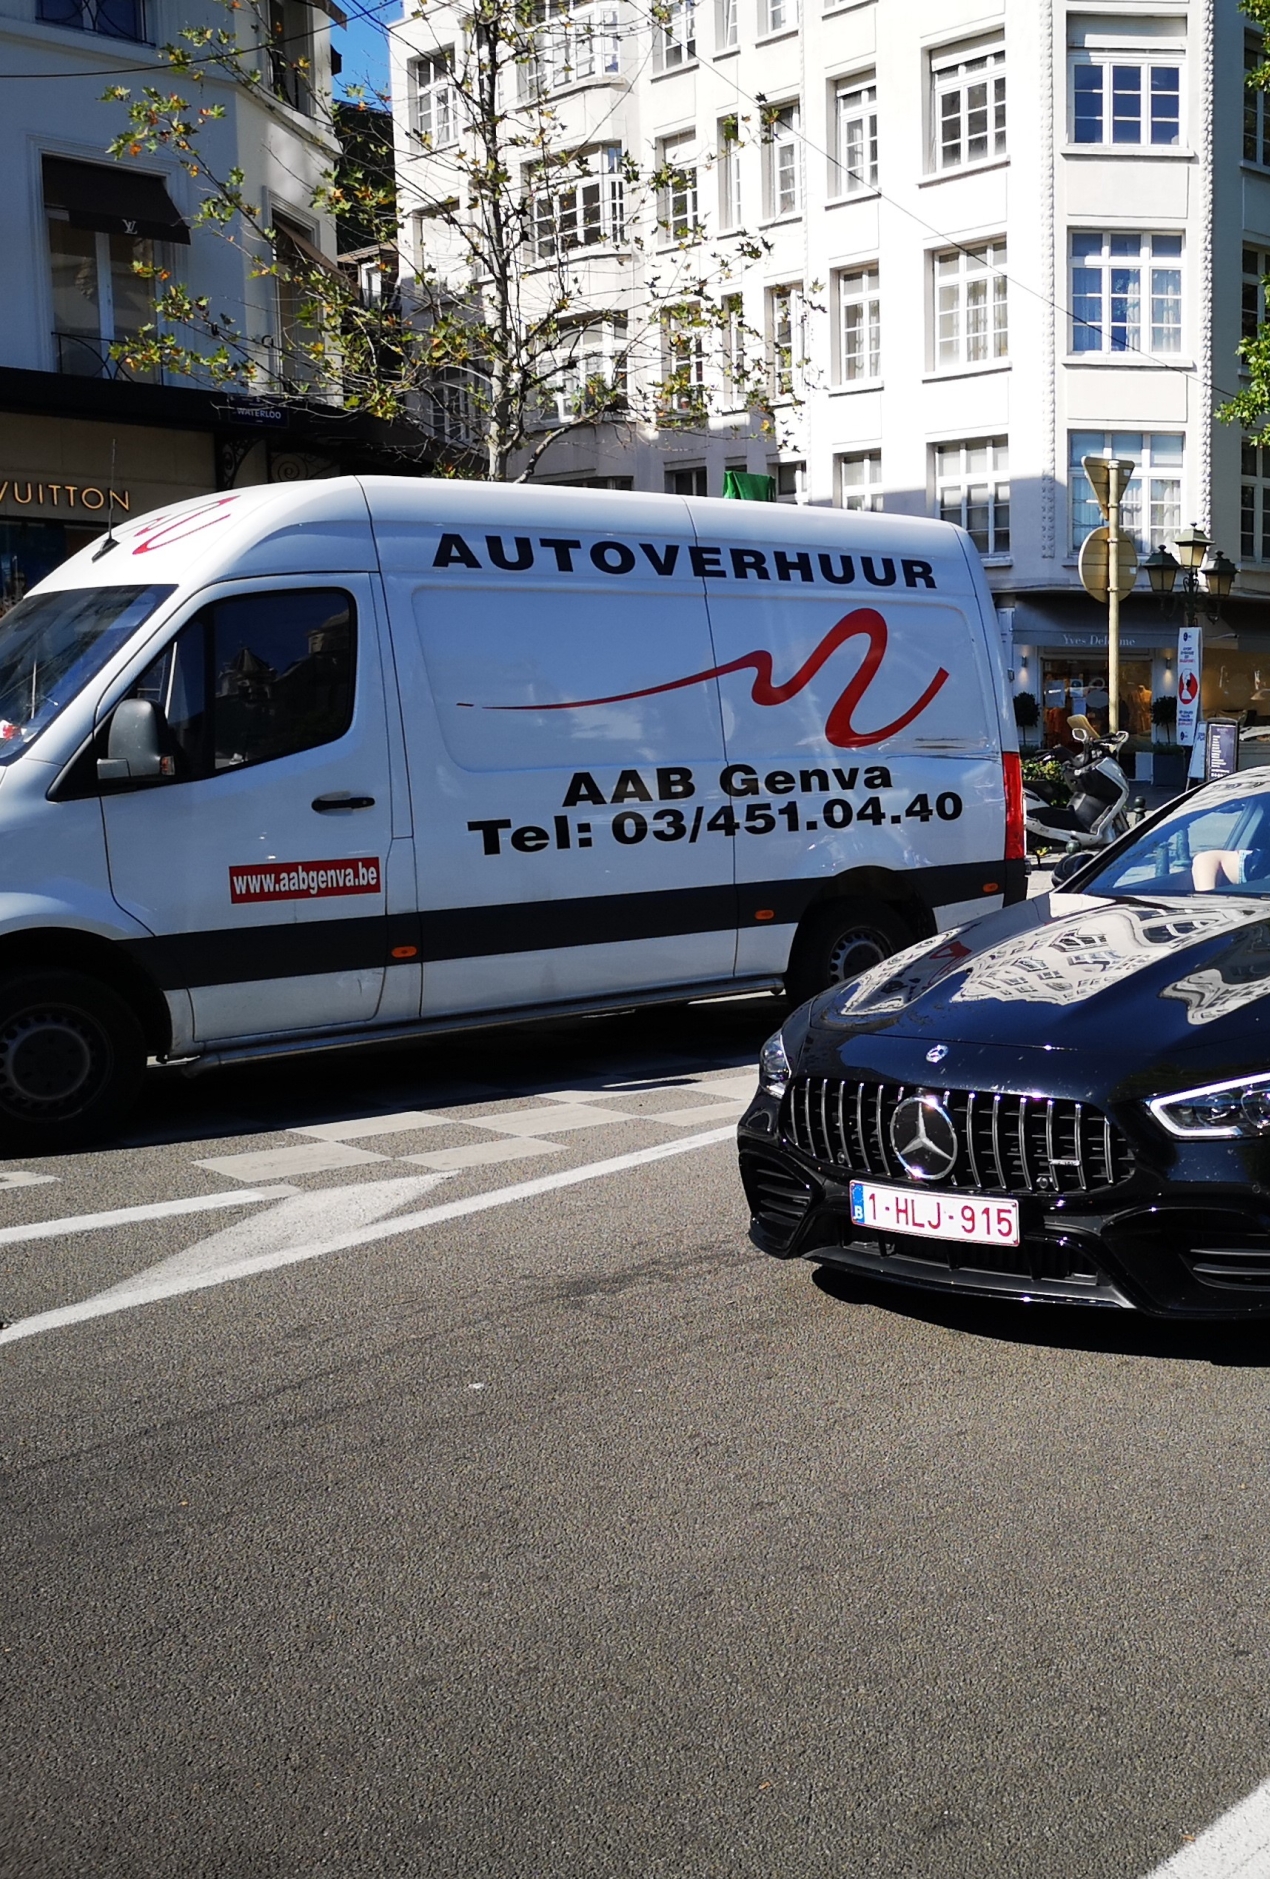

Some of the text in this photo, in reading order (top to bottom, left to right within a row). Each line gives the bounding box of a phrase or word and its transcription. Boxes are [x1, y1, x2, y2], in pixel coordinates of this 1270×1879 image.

[236, 407, 282, 419] WATERLOO
[432, 533, 938, 589] AUTOVERHUUR
[1063, 634, 1136, 646] Yves Delme
[562, 764, 893, 808] AAB Genva
[468, 792, 963, 855] Tel: 03/451.04.40
[233, 861, 378, 895] www.aabgenva.be
[854, 1206, 863, 1220] B
[868, 1193, 1013, 1237] 1-HLJ-915
